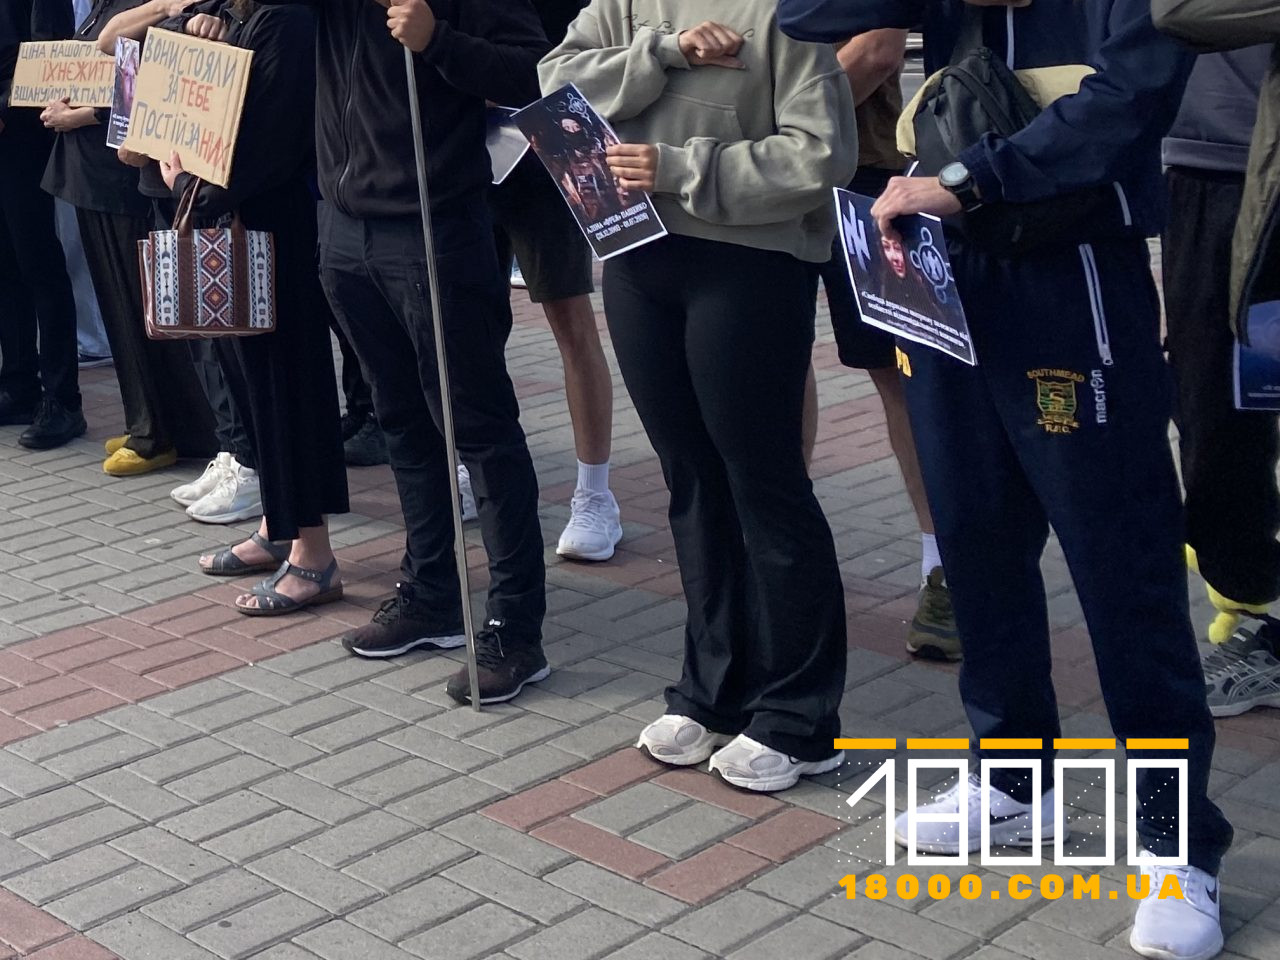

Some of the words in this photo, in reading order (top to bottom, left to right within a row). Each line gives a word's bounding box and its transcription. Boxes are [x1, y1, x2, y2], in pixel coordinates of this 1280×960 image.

[21, 44, 46, 60] ЦІНА
[50, 44, 92, 58] НАШОГО
[73, 60, 115, 82] ЖИТТ
[181, 77, 213, 112] ТЕБЕ
[1026, 368, 1085, 383] SOUTHMEAD
